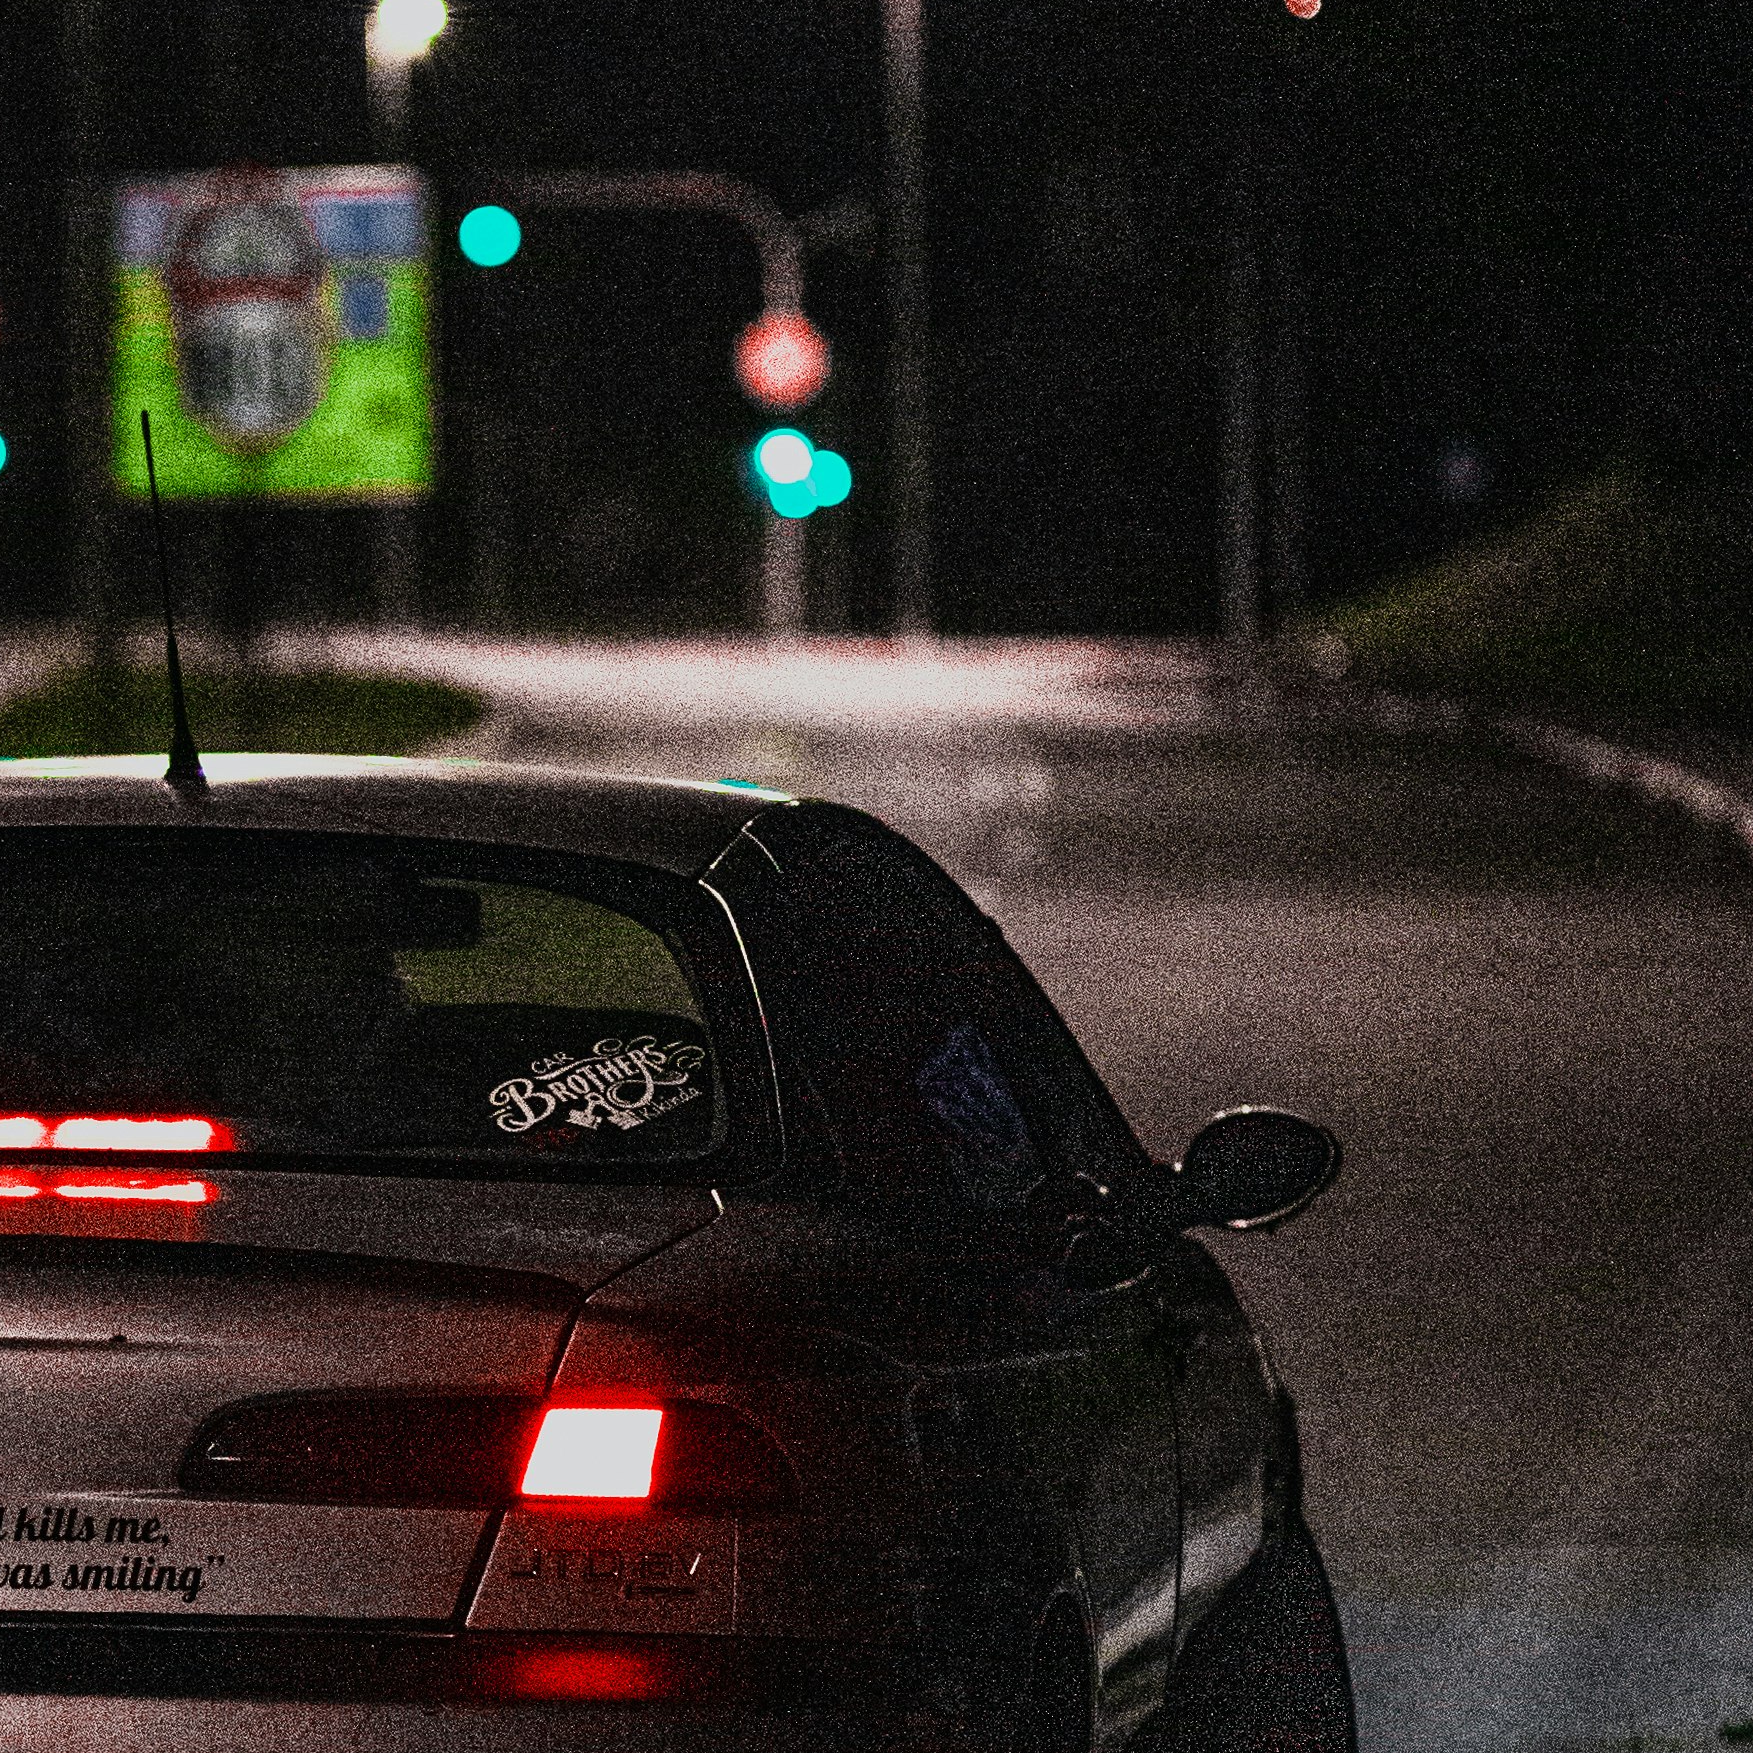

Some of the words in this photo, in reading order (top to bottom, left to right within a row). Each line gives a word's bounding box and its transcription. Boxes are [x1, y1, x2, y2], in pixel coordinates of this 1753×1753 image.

[488, 1035, 706, 1132] BROTHERS
[531, 1051, 576, 1075] CAR
[14, 1506, 95, 1542] kills
[105, 1516, 169, 1547] me,
